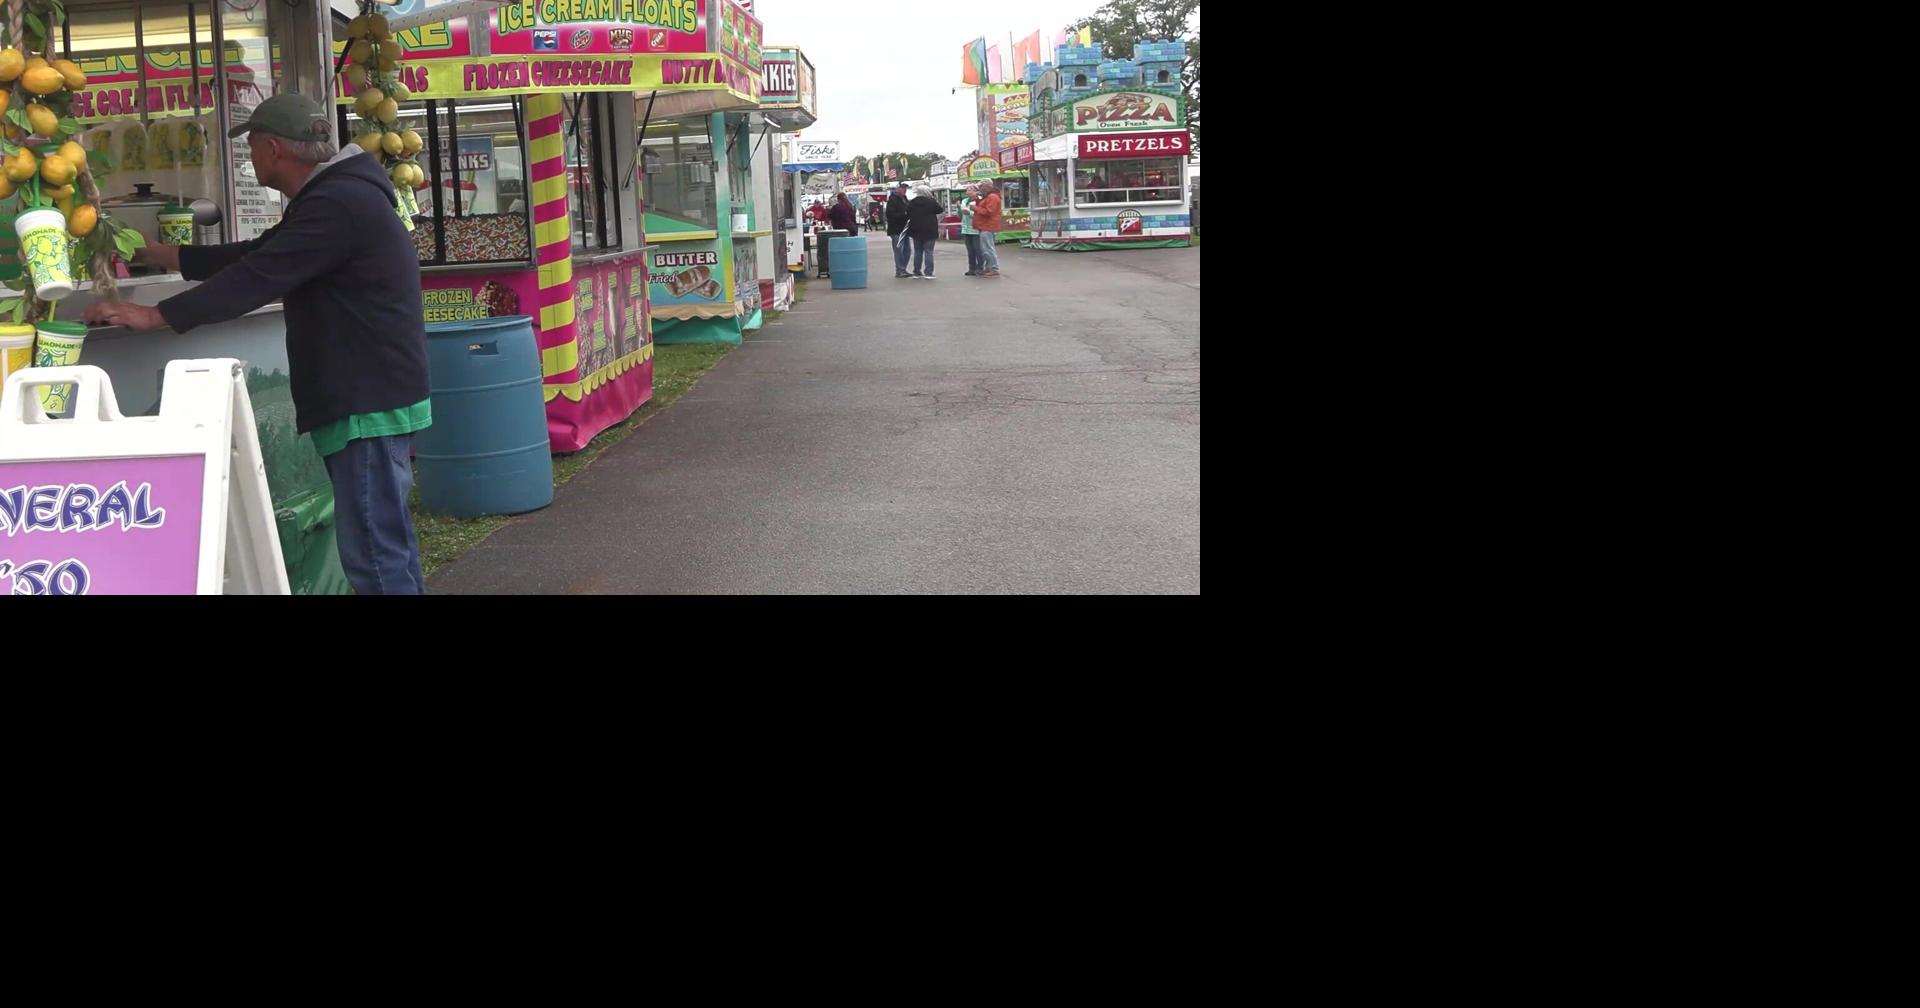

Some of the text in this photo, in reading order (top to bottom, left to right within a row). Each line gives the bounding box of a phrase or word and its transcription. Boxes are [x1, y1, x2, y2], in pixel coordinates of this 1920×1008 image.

[499, 0, 698, 34] ICE CREAM FLOATS
[463, 59, 633, 91] FROZEN CHEESECAKE
[661, 58, 714, 84] NUTTY
[71, 91, 96, 118] CE
[1076, 99, 1176, 126] PIZZA
[800, 144, 835, 155] Fiske
[1086, 136, 1183, 152] PRETZELS
[432, 153, 490, 172] RNKS
[655, 252, 717, 266] BUTTER
[423, 289, 472, 306] FROZEN
